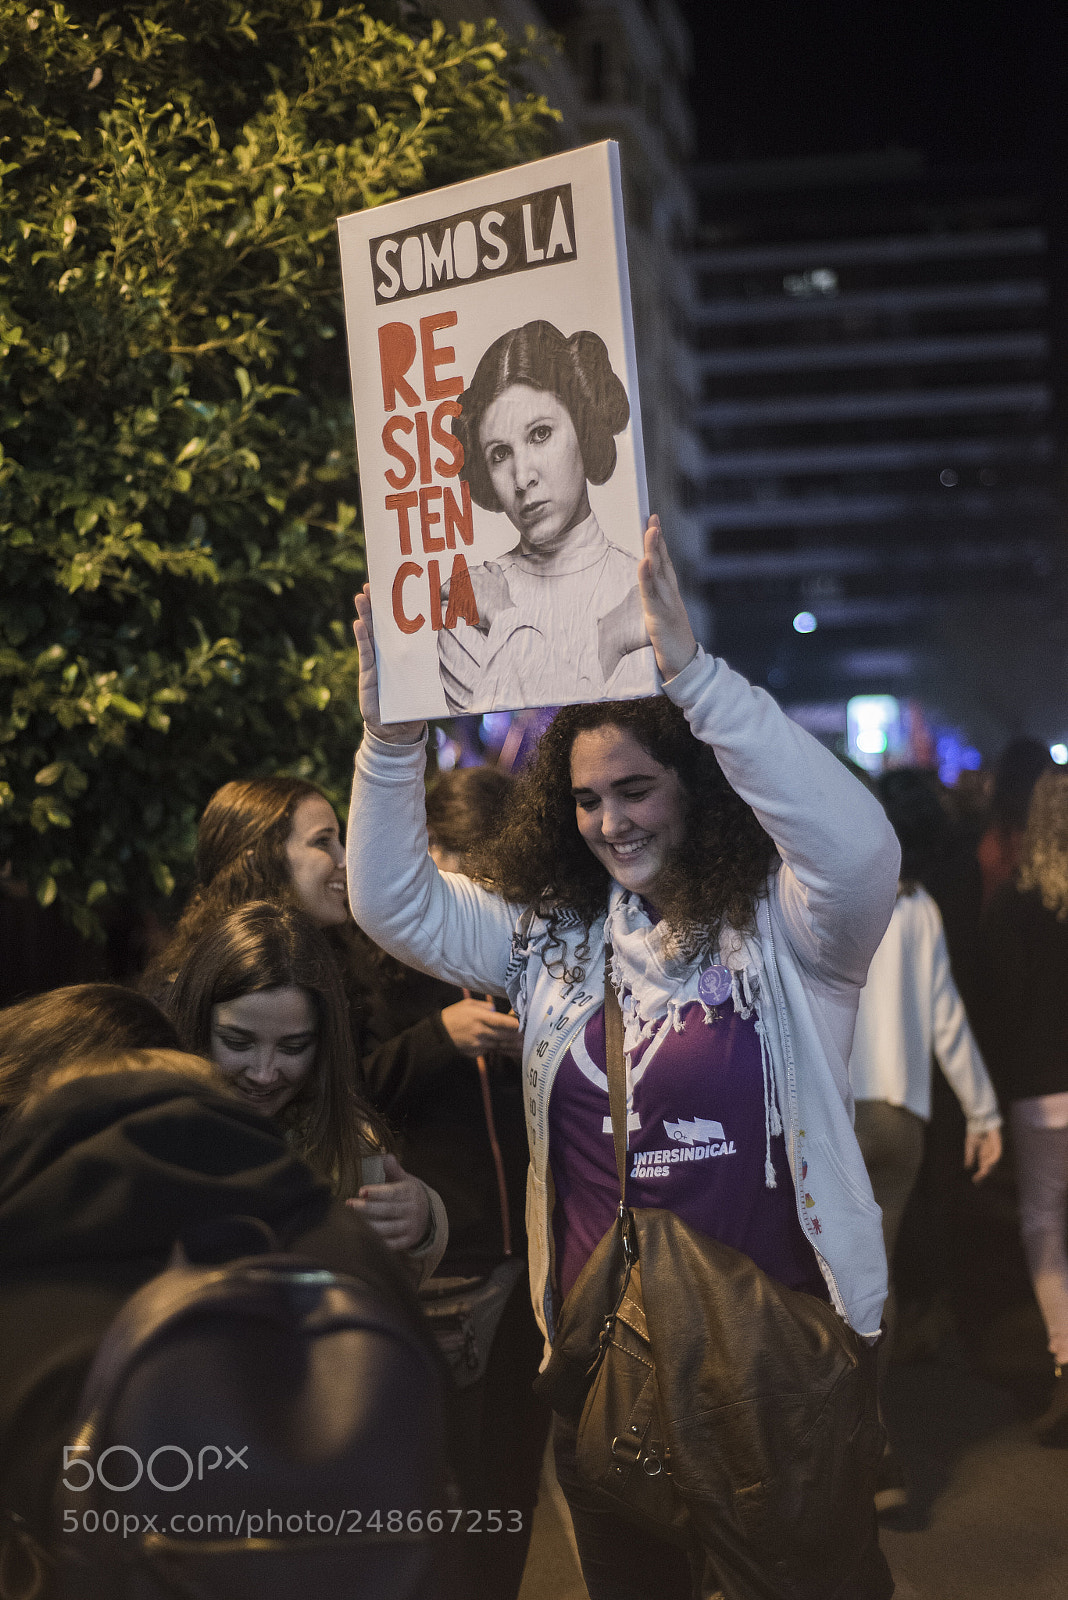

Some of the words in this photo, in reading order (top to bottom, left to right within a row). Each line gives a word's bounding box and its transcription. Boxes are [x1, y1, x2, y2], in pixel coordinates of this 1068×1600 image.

[376, 210, 508, 299] SOMOS
[522, 195, 573, 263] LA
[378, 310, 464, 412] RE
[381, 399, 465, 490] SIS
[385, 480, 474, 555] TEN
[392, 553, 480, 635] CIA
[630, 1165, 670, 1178] dones
[633, 1141, 737, 1166] INTERSINDICAL
